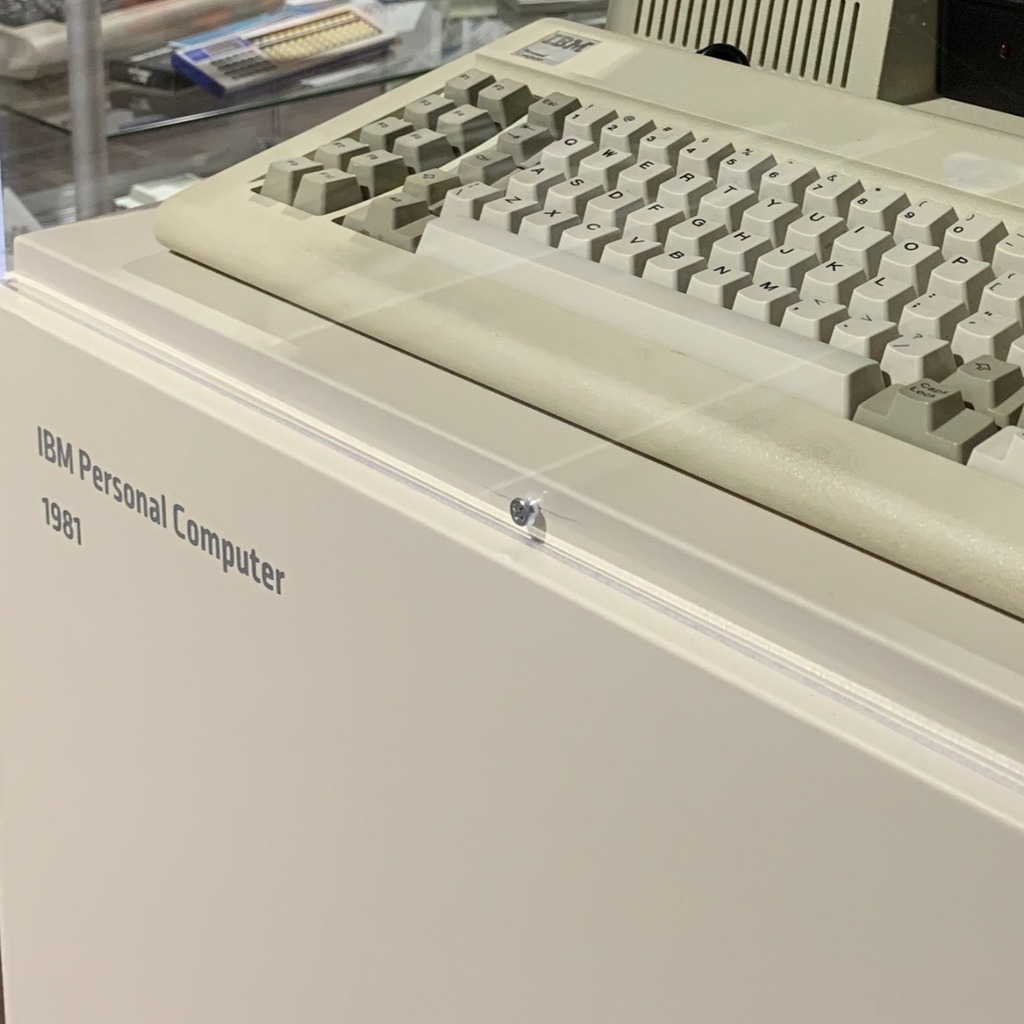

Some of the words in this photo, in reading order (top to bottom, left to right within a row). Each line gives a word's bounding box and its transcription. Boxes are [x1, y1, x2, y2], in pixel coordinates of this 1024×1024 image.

[541, 34, 595, 53] IBM
[542, 98, 558, 107] Esc
[564, 138, 578, 146] Q
[602, 148, 618, 158] W
[639, 160, 655, 170] E
[726, 158, 737, 166] 5
[531, 166, 546, 175] A
[768, 171, 780, 179] 6
[679, 172, 695, 183] R
[570, 178, 585, 187] S
[723, 185, 738, 194] T
[608, 190, 624, 199] D
[505, 196, 522, 204] Z
[767, 198, 782, 208] Y
[857, 197, 868, 205] 8
[648, 203, 664, 212] F
[544, 209, 561, 218] X
[809, 212, 825, 222] U
[904, 211, 915, 219] 9
[586, 223, 601, 231] C
[691, 218, 707, 227] G
[630, 236, 646, 245] V
[733, 231, 751, 241] H
[780, 247, 794, 255] J
[904, 242, 919, 251] O
[668, 250, 685, 259] B
[952, 256, 968, 266] P
[713, 265, 732, 275] N
[825, 261, 844, 271] K
[759, 281, 779, 291] M
[874, 277, 886, 287] L
[36, 425, 74, 475] IBM
[78, 448, 168, 529] Personal
[173, 503, 286, 596] Computer
[42, 497, 82, 546] 1981
